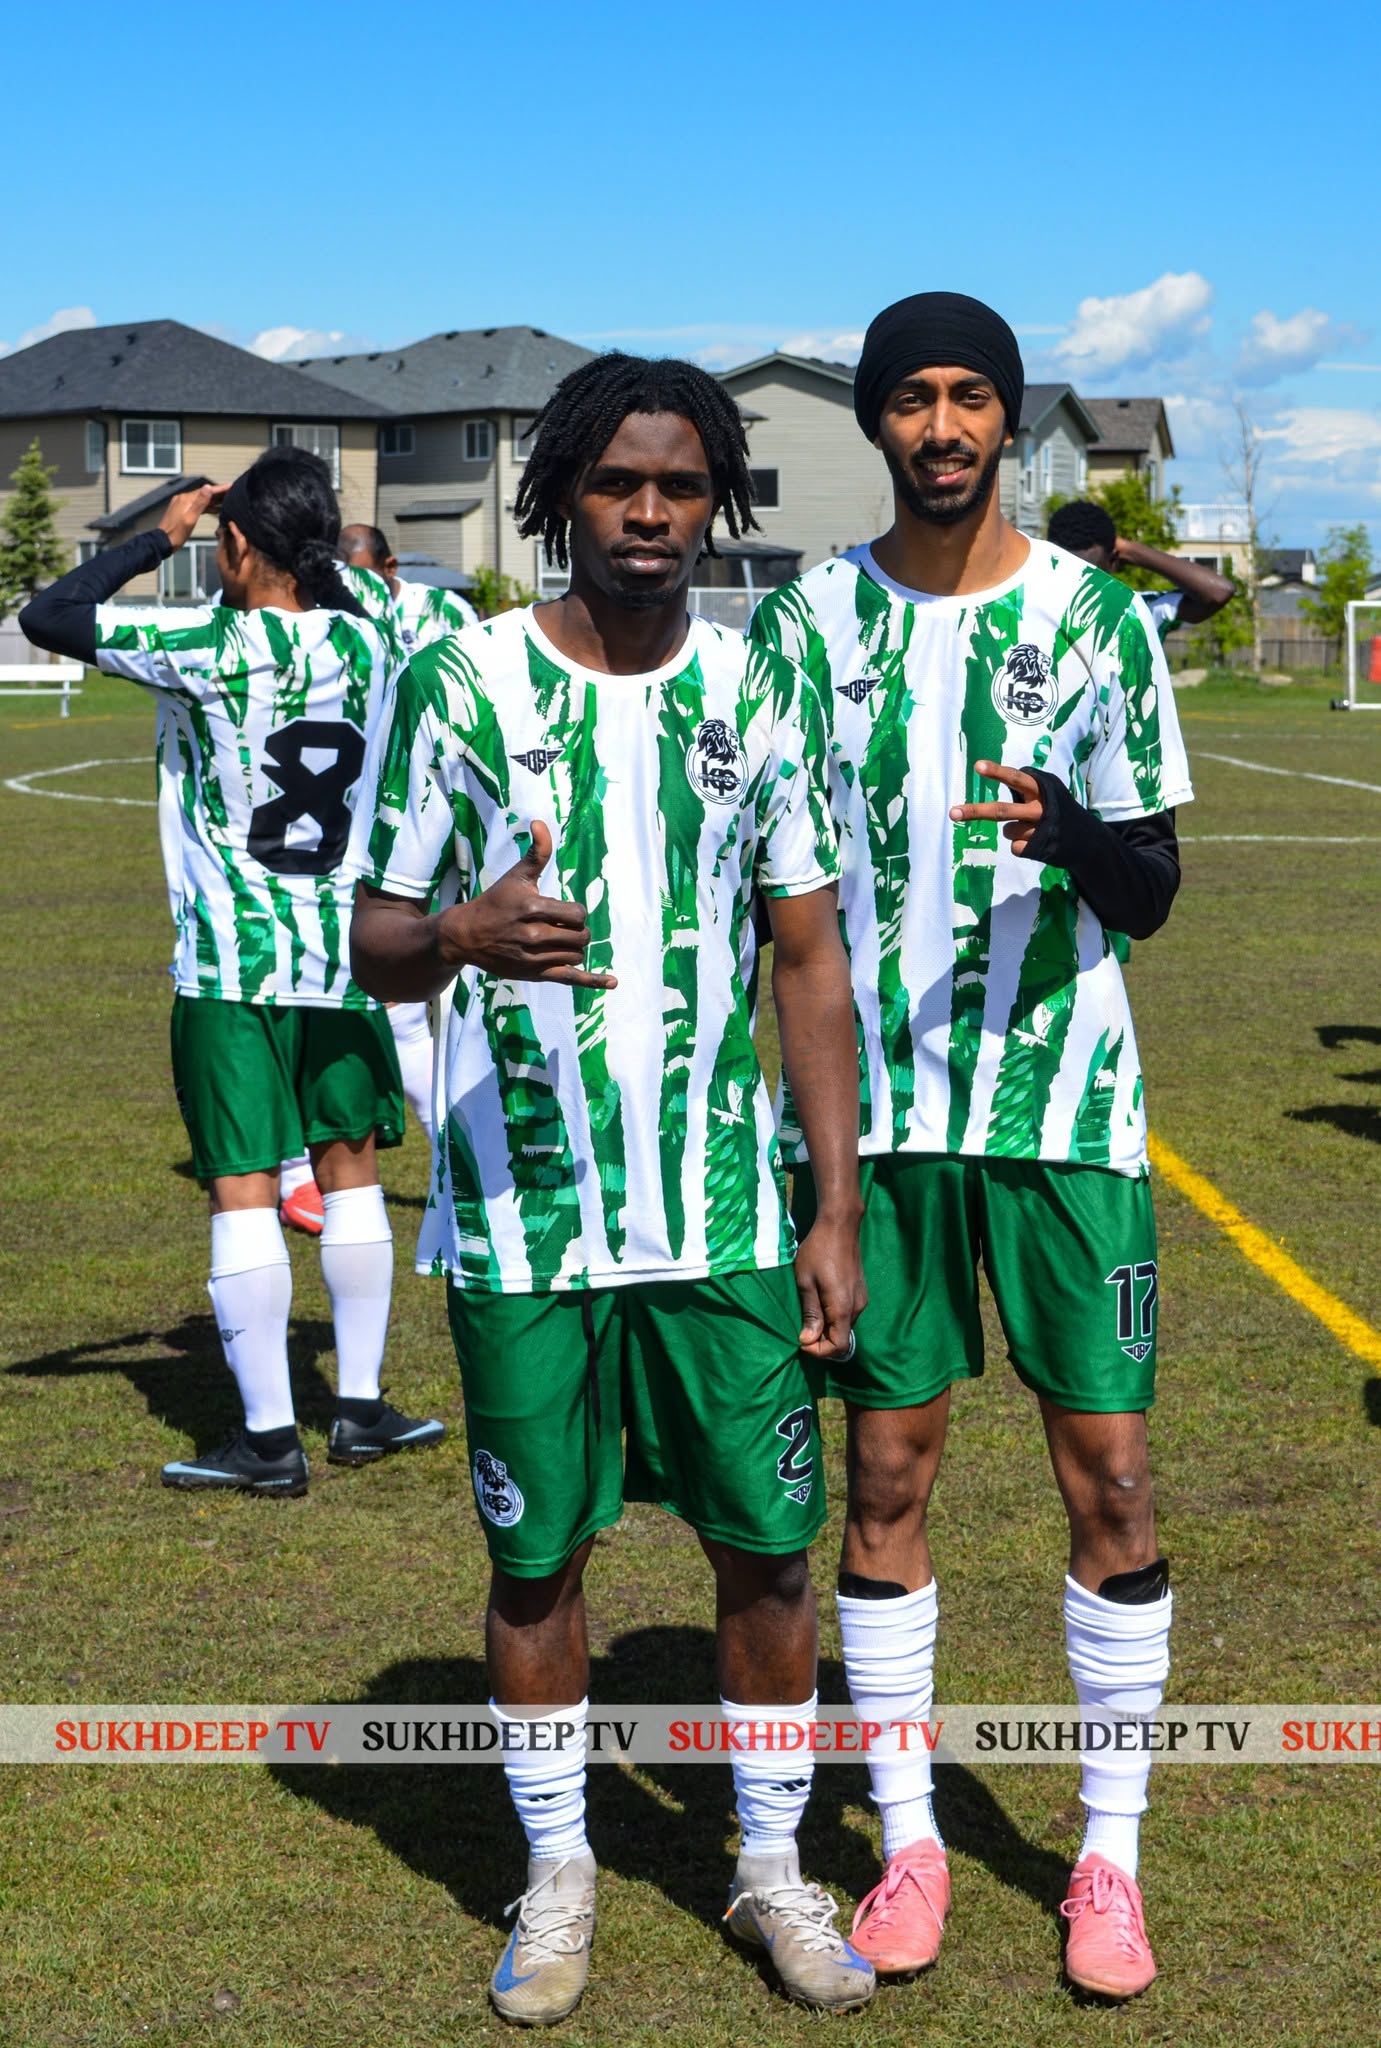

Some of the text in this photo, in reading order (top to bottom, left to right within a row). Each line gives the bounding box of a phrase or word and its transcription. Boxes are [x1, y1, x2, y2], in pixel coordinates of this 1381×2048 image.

[246, 717, 368, 877] 8
[1104, 1260, 1158, 1340] 17
[776, 1405, 813, 1483] 2
